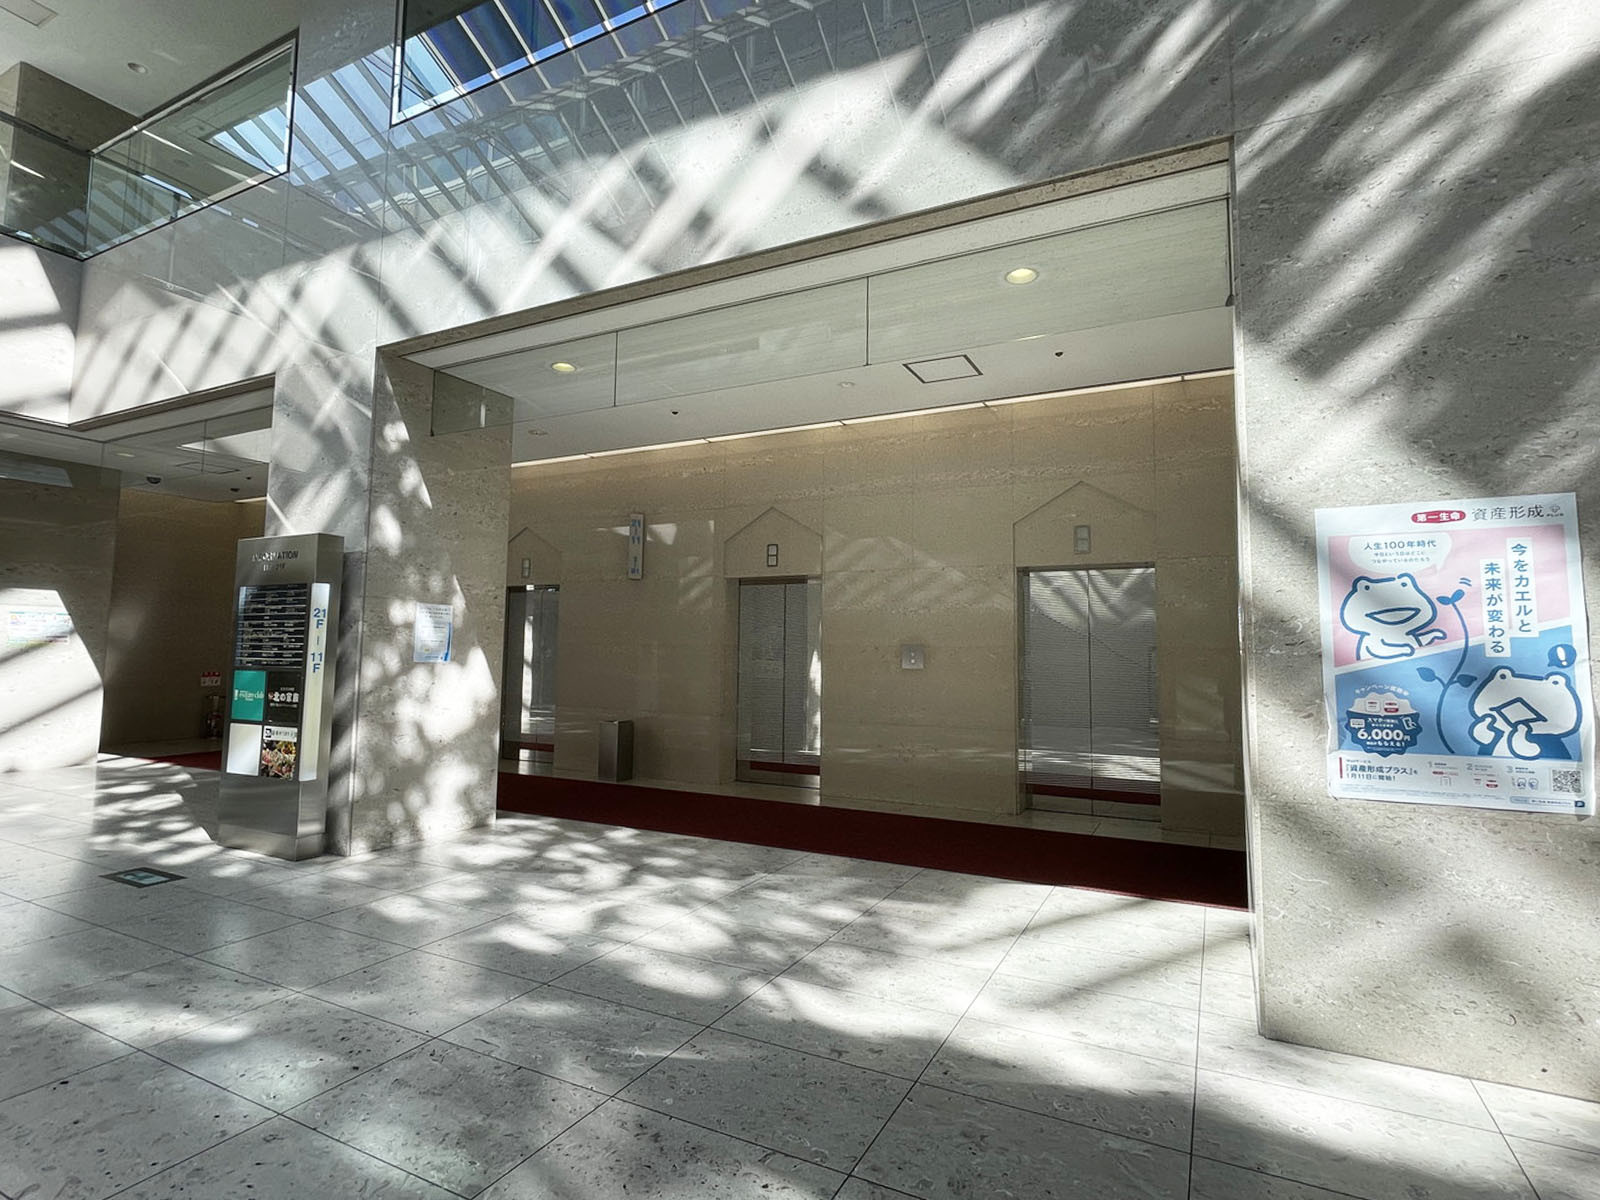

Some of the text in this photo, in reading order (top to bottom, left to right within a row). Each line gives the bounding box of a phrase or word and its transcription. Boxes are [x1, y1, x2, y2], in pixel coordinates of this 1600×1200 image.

[1415, 510, 1460, 523] 第一生命
[1471, 504, 1545, 521] 資産形成
[1363, 539, 1437, 551] 人生100年時代
[1511, 543, 1533, 633] 今をカエルと
[1484, 562, 1505, 654] 未来が変わる
[1357, 728, 1411, 742] 6,000円
